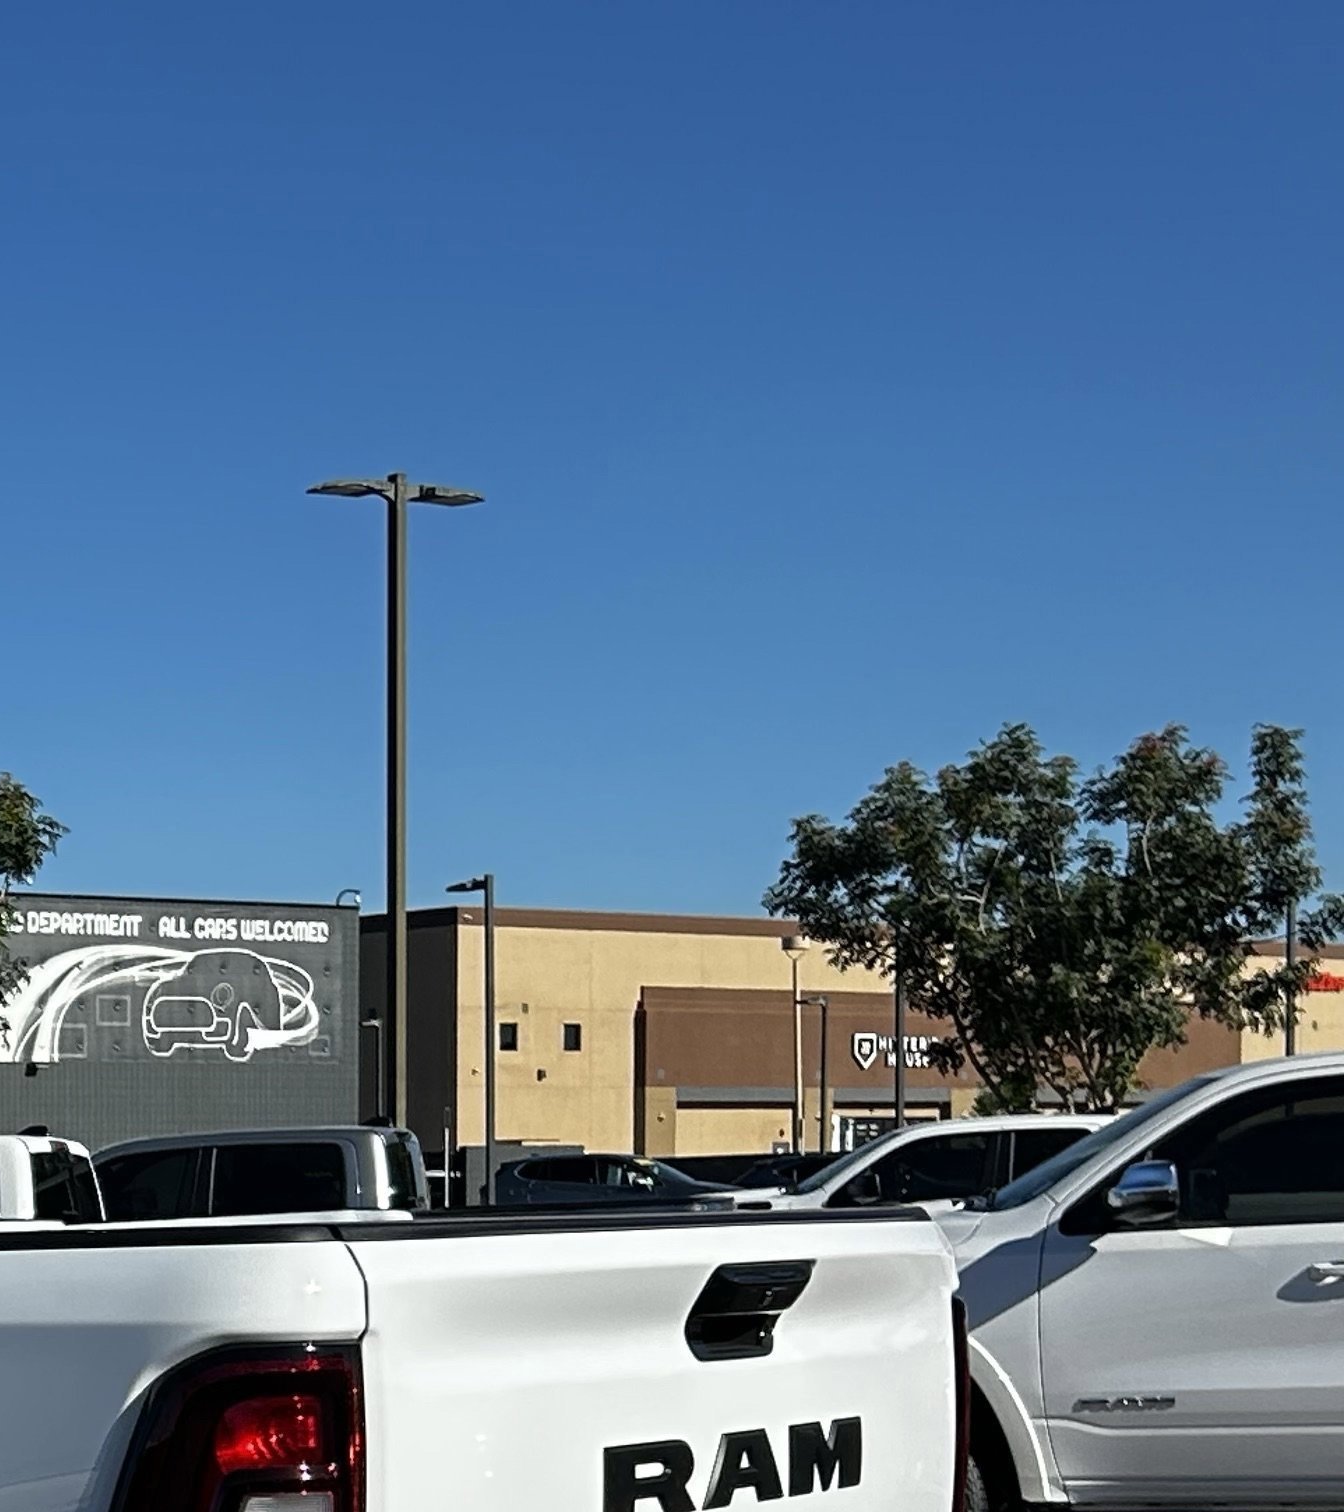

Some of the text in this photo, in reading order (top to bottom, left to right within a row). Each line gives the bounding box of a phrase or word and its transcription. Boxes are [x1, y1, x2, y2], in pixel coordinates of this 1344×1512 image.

[26, 910, 143, 937] DEPARTMENT
[158, 916, 192, 939] ALL
[193, 916, 238, 940] CARS
[240, 919, 330, 943] WELCOMED
